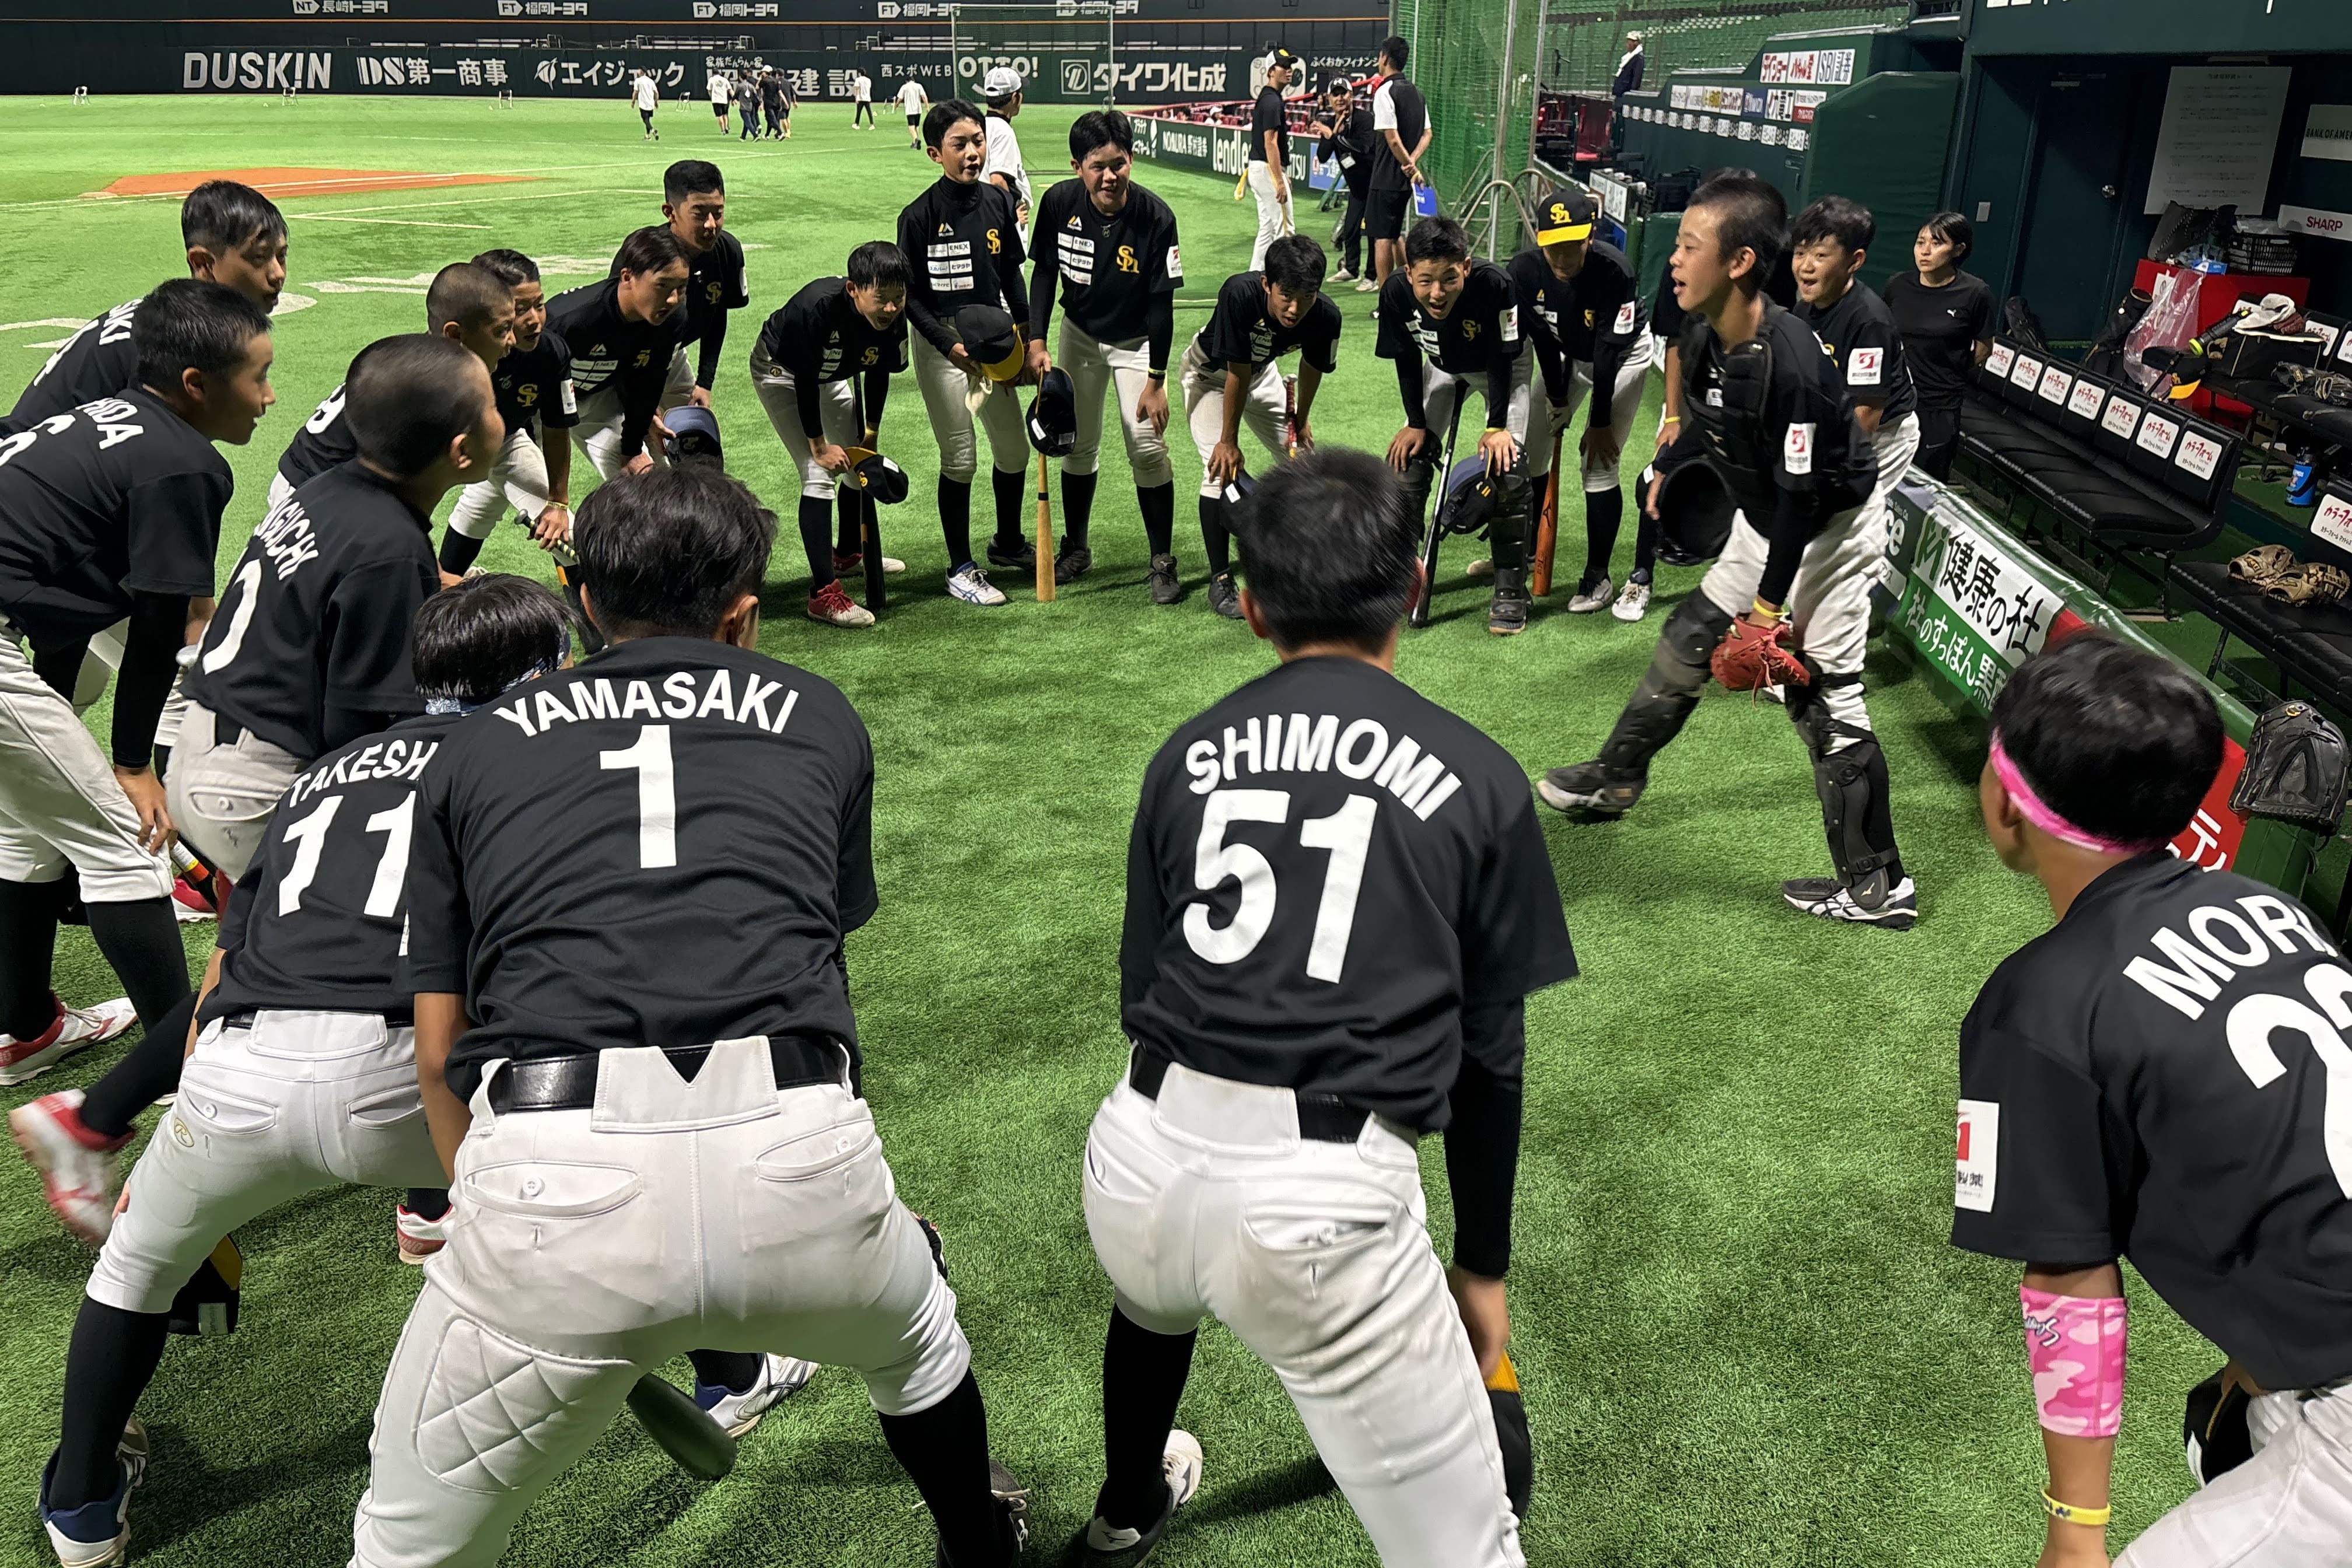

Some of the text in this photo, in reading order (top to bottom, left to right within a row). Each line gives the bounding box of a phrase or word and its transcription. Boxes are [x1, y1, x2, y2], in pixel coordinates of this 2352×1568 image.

[321, 0, 388, 13] 長崎トヨタ
[525, 2, 587, 16] 福岡トヨタ
[719, 2, 778, 17] 福岡トヨタ
[406, 58, 509, 87] 第一商事
[881, 64, 952, 78] 西スポWEB
[1093, 62, 1227, 93] ダイワ化成
[2306, 215, 2343, 232] SHARP
[492, 669, 800, 737] YAMASAKI
[1185, 713, 1463, 822] SHIMOMI
[599, 724, 677, 869] 1
[278, 790, 416, 918] 11
[1182, 789, 1378, 984] 51
